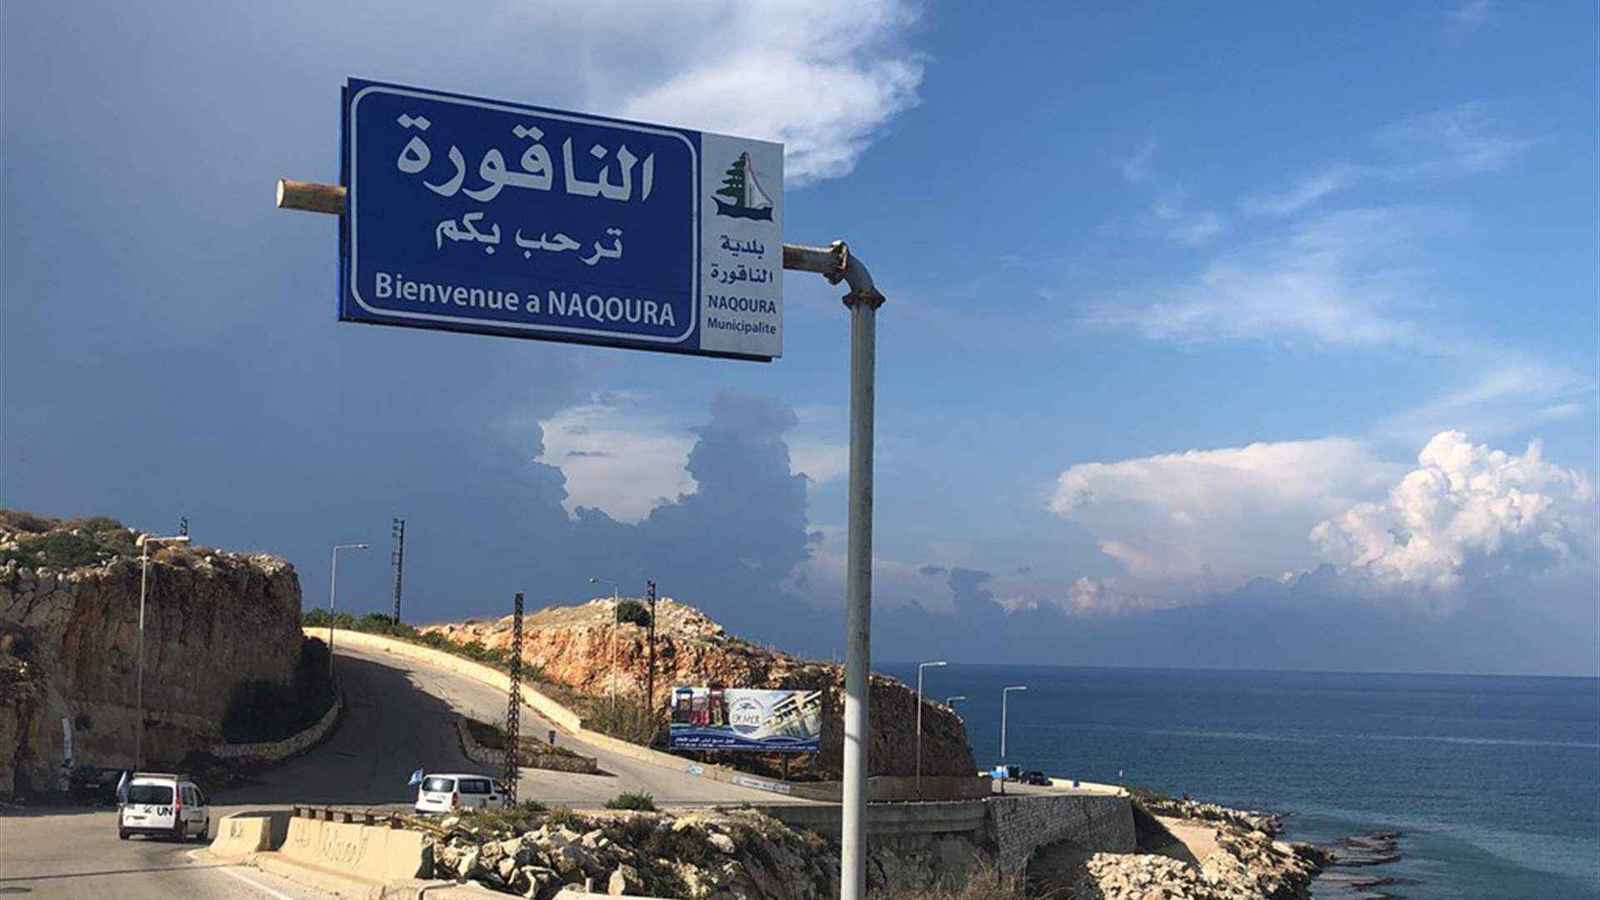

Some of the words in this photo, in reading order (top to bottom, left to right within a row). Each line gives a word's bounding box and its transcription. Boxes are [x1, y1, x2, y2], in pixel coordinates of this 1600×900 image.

[397, 112, 655, 202] الناقورة
[436, 211, 500, 255] بكم
[515, 227, 624, 265] ترحب
[720, 234, 765, 259] بلدية
[710, 263, 773, 284] الناقورة
[375, 272, 519, 311] Bienvenue
[526, 295, 540, 313] a
[548, 291, 676, 327] NAQOURA
[708, 295, 776, 314] NAQOURA
[707, 317, 776, 334] Municipalite
[157, 807, 173, 816] UN
